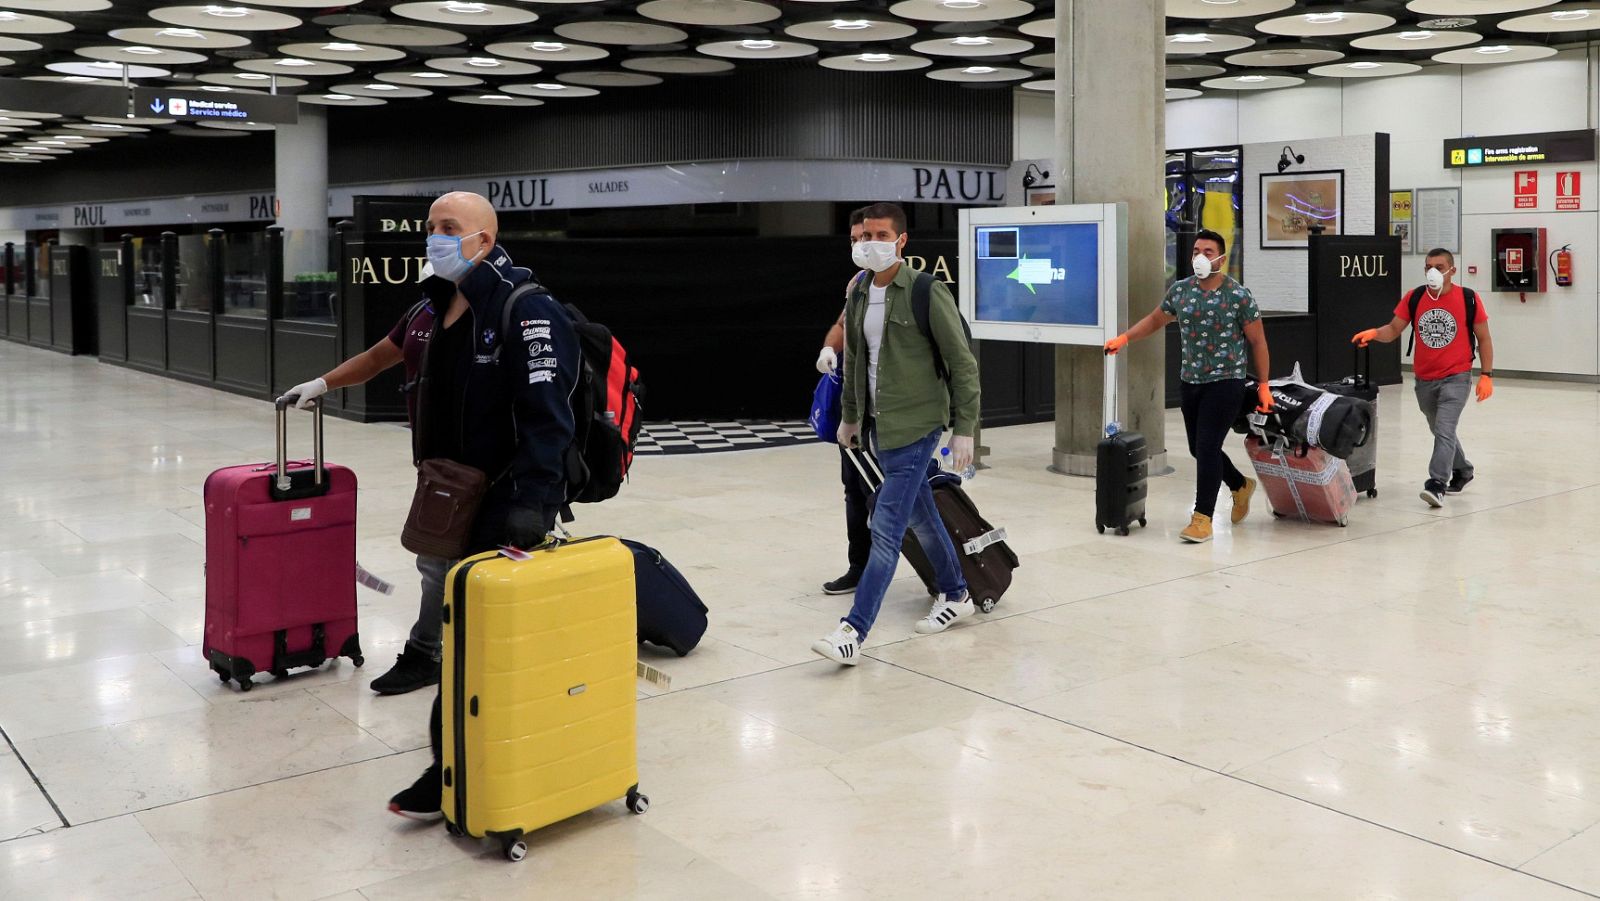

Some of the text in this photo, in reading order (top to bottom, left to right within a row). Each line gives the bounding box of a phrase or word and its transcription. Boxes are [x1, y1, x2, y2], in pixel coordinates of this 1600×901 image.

[189, 100, 213, 108] Medical
[190, 108, 220, 116] Servicio
[487, 179, 554, 207] PAUL
[588, 180, 629, 194] SALADES
[912, 168, 1004, 201] PAUL
[74, 206, 107, 226] PAUL
[1340, 254, 1388, 278] PAUL
